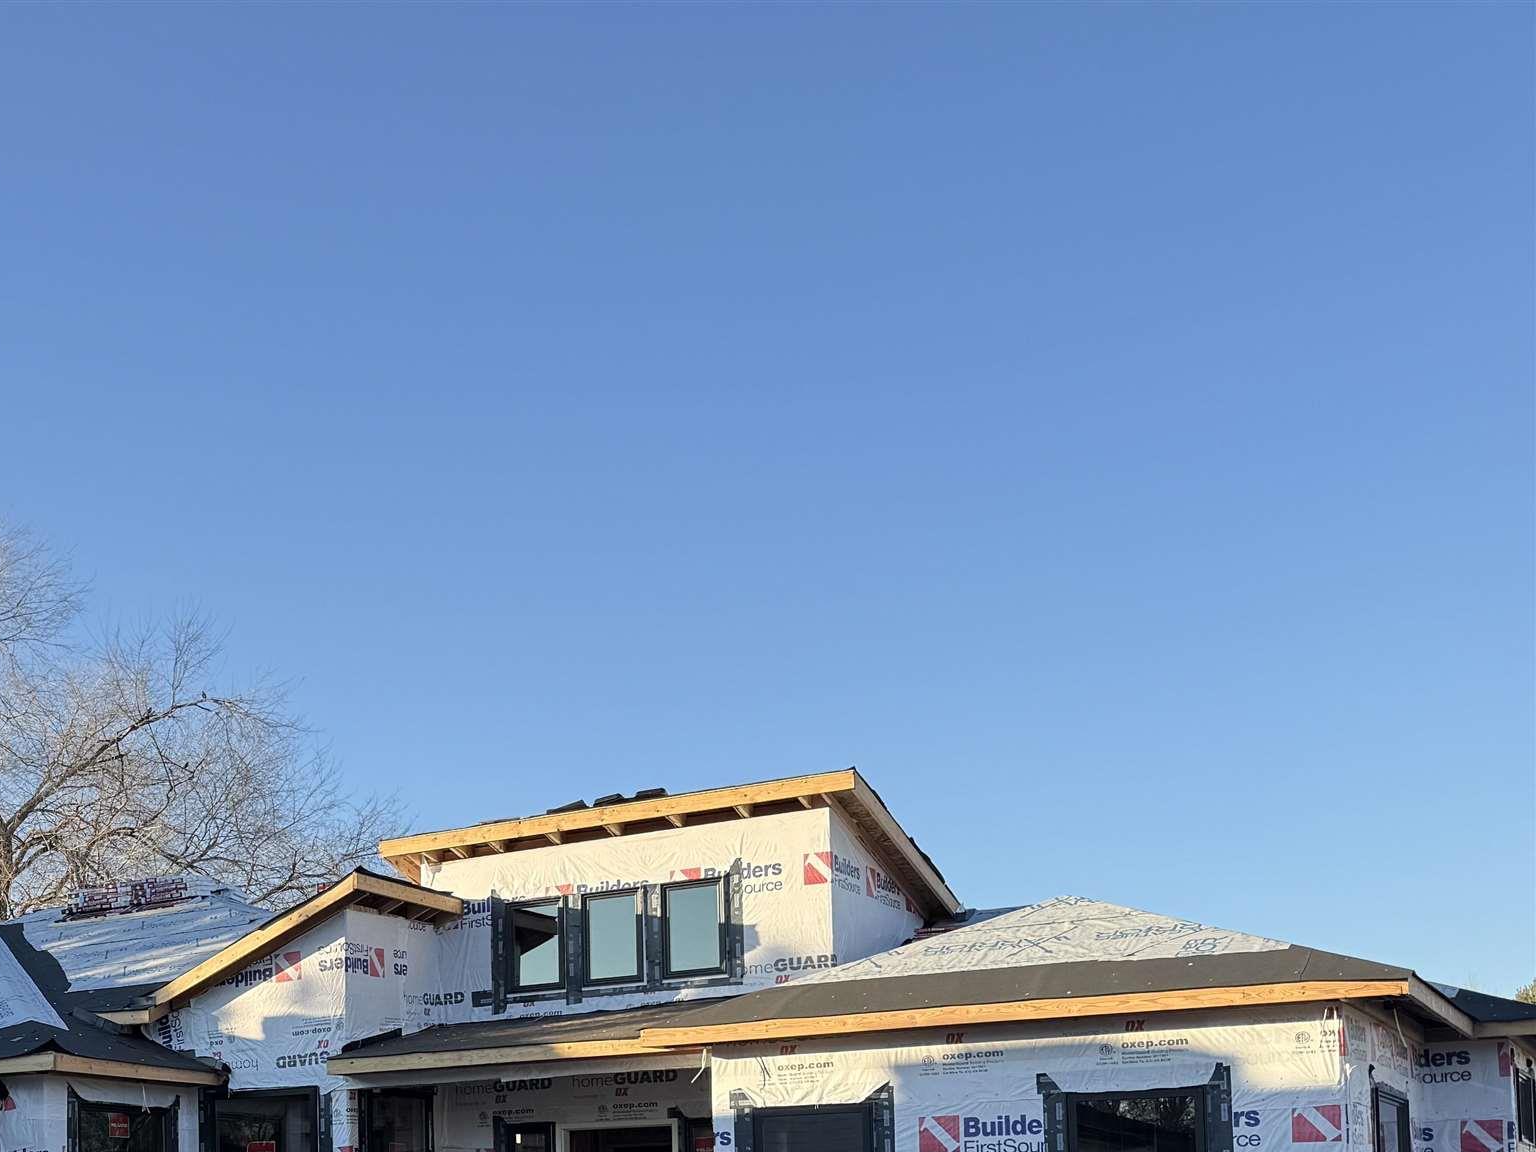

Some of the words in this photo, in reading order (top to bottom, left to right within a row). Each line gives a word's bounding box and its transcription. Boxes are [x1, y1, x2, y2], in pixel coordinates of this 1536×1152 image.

[1121, 1037, 1189, 1049] oxep.com
[942, 1049, 1004, 1061] oxep.com
[777, 1060, 834, 1072] oxep.com
[571, 1068, 679, 1090] homeGUARD
